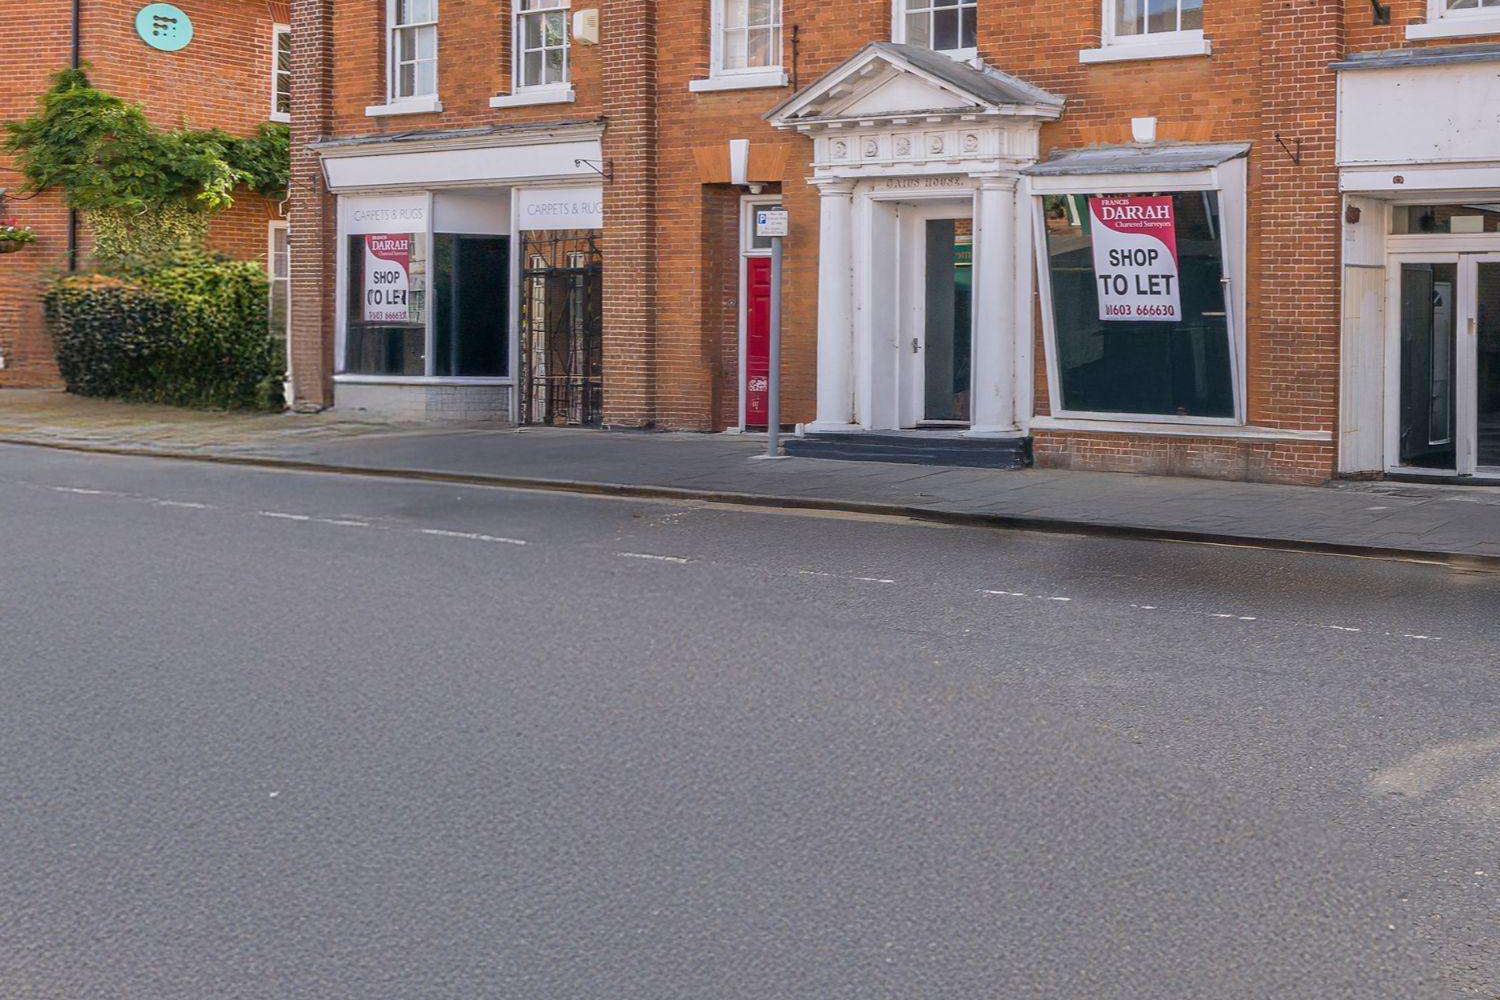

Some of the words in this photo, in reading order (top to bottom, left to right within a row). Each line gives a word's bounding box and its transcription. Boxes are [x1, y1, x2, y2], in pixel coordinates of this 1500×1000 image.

[1101, 198, 1130, 206] FRANCIS
[353, 208, 389, 221] CARPETS
[400, 208, 424, 220] RUGS
[527, 203, 569, 216] CARPETS
[571, 203, 579, 215] &
[1102, 205, 1171, 220] DARRAH
[1144, 220, 1172, 229] Surveyors
[372, 239, 408, 250] DARRAH
[1109, 248, 1159, 267] SHOP
[373, 271, 400, 284] SHOP
[1099, 274, 1129, 296] TO
[1135, 274, 1176, 296] LET
[1136, 304, 1175, 316] 666630
